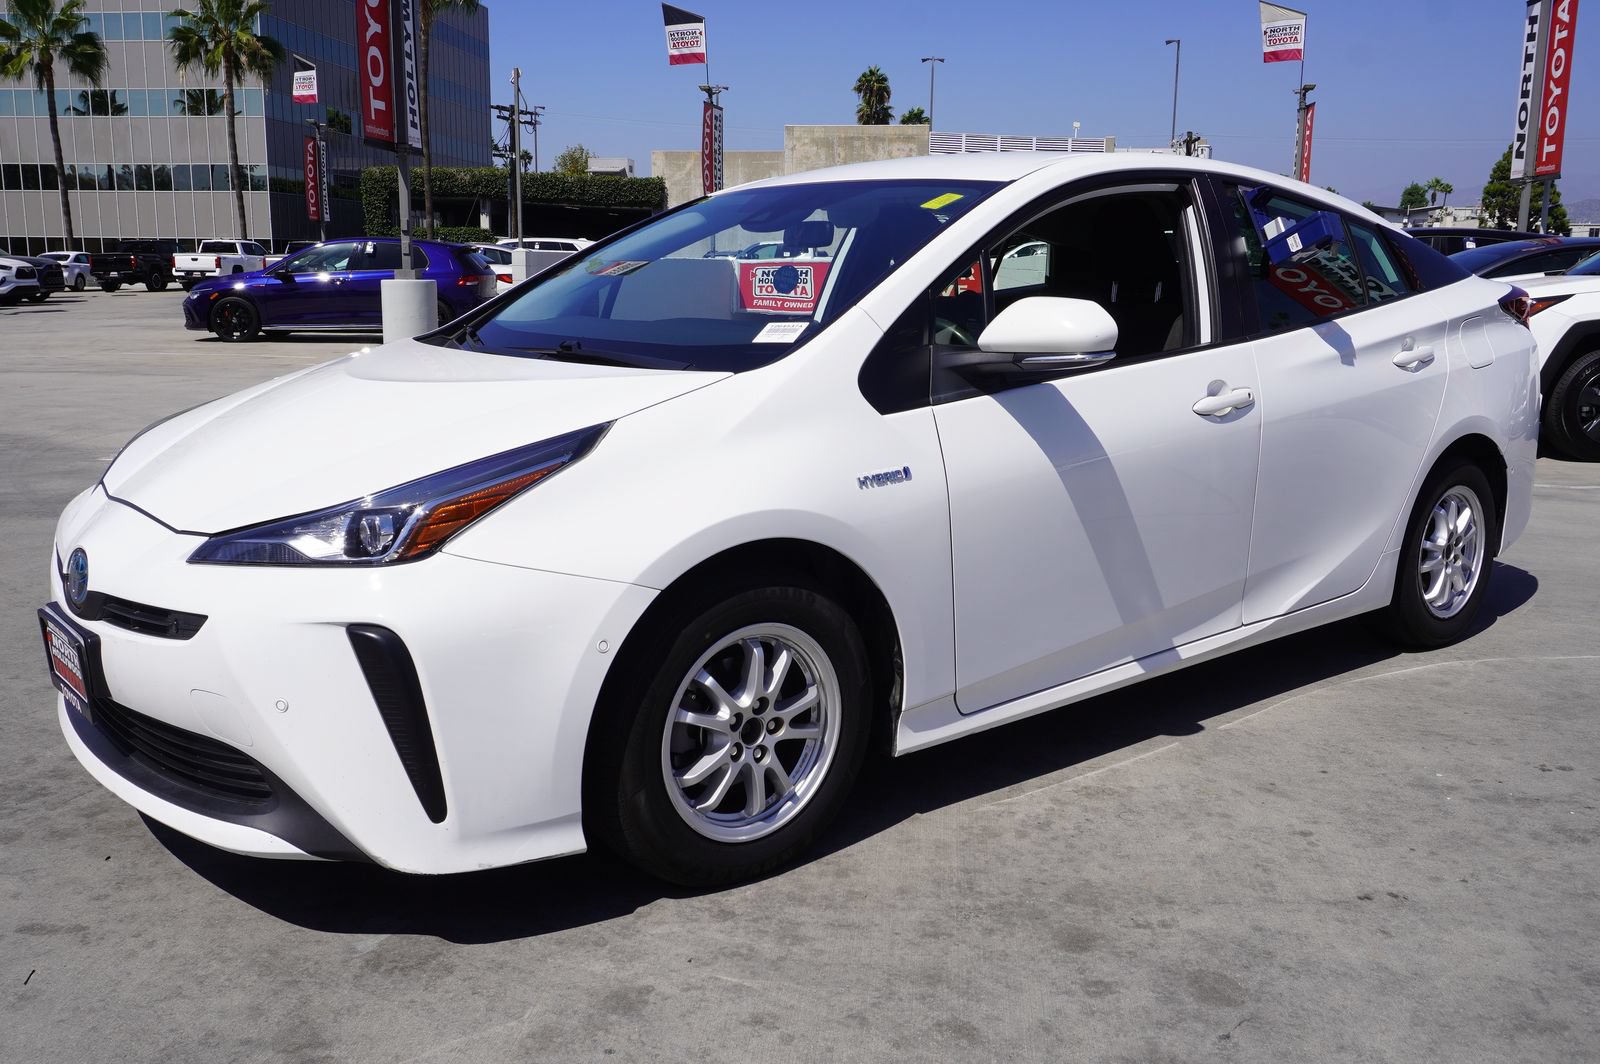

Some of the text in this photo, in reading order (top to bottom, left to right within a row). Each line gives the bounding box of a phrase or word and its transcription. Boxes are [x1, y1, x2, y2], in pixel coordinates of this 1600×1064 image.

[1267, 30, 1300, 39] HOLLYWOOD
[1267, 36, 1299, 45] TOYOTA
[1269, 25, 1300, 34] NORTH
[365, 0, 386, 120] TOY
[1514, 14, 1539, 160] NORTH
[1542, 0, 1571, 162] TOYOTA
[307, 141, 317, 215] TOYOTA
[753, 299, 814, 309] FAMILY OWNED
[857, 469, 904, 490] HYBRID
[52, 633, 80, 666] NORTH
[60, 683, 82, 714] TOYOTA
